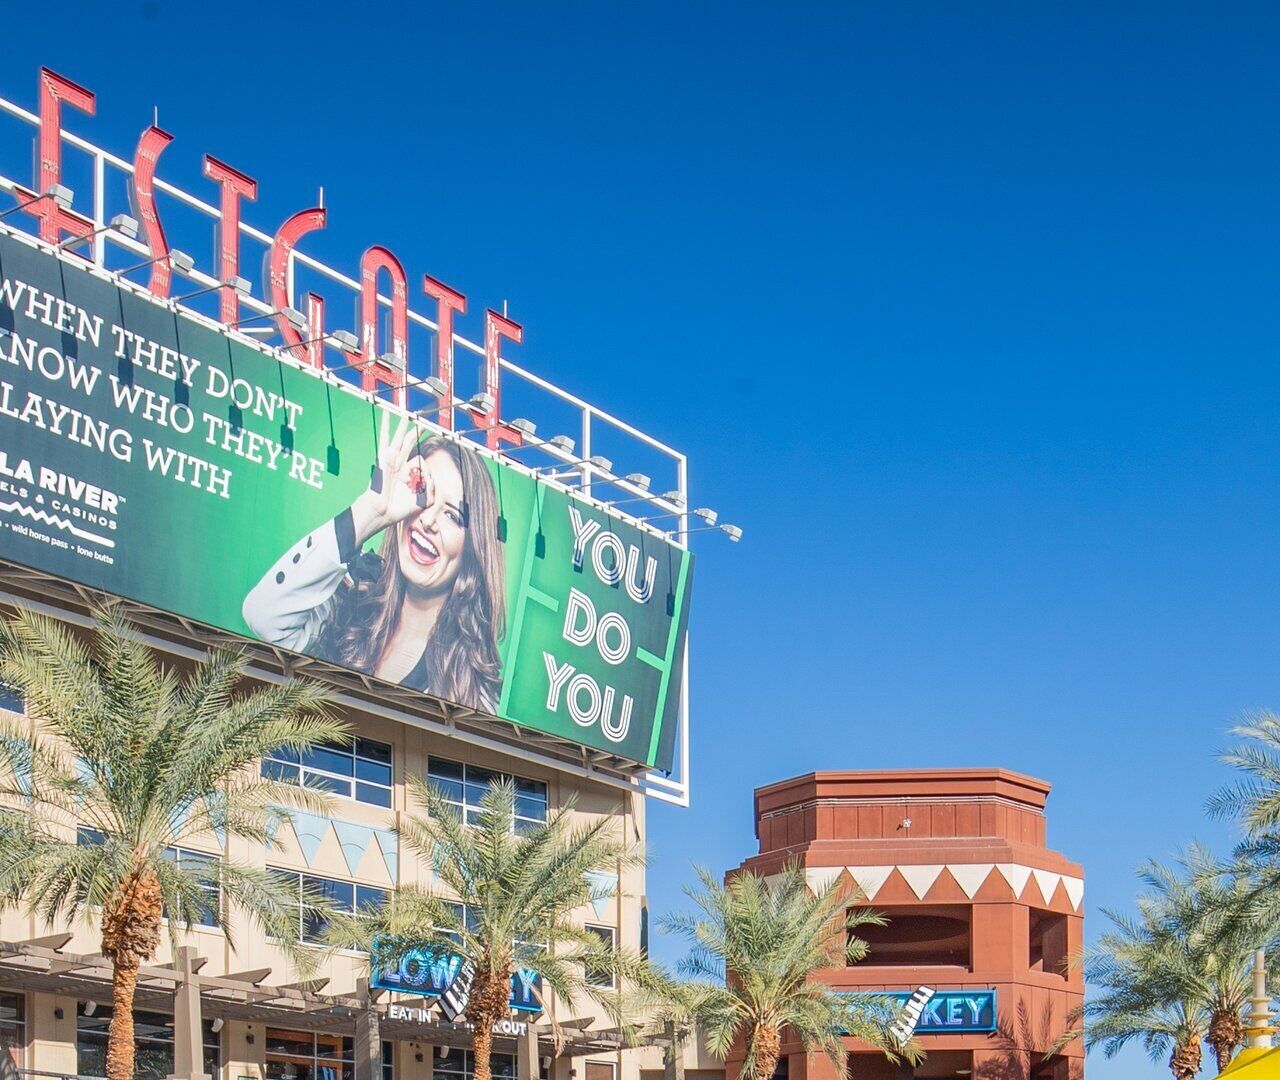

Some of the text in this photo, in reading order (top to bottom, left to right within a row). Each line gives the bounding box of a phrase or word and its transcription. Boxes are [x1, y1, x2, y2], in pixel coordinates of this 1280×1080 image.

[111, 324, 202, 388] THEY
[205, 365, 304, 432] DON'T
[108, 373, 195, 434] WHO
[202, 412, 326, 489] THEY'RE
[142, 438, 233, 499] WITH
[35, 494, 45, 504] &
[51, 500, 118, 530] CASINOS
[11, 523, 28, 536] wild
[29, 528, 50, 543] horse
[51, 535, 69, 550] pass
[76, 545, 94, 558] lone
[94, 548, 114, 565] butte
[568, 504, 658, 604] YOU
[562, 587, 631, 665] DO
[542, 651, 634, 743] YOU
[390, 1005, 432, 1023] EAT IN
[502, 1021, 527, 1036] OUT
[921, 996, 990, 1026] KEY
